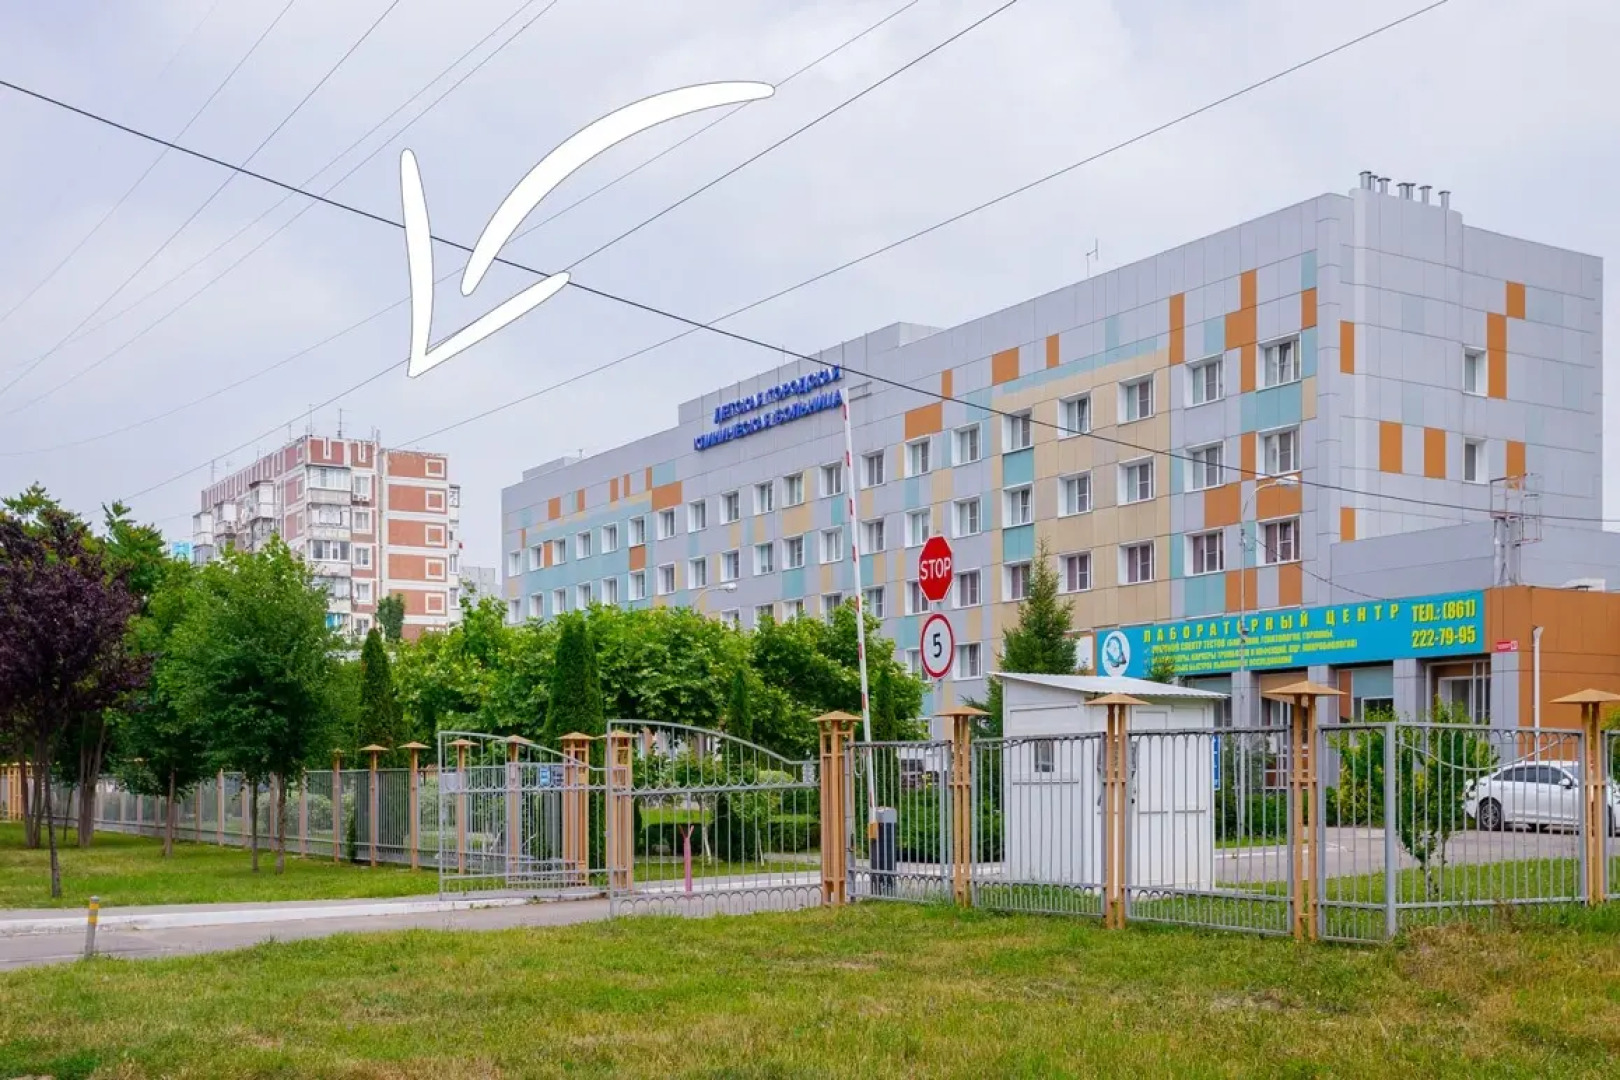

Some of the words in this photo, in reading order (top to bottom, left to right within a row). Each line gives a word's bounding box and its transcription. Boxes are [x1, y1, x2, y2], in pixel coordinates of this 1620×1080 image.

[714, 391, 763, 424] ДЕТСКАЯ
[765, 364, 840, 404] ГОРОДСКАЯ
[693, 415, 771, 451] КЛИНИЧЕСКАЯ
[772, 388, 843, 425] БОЛЬНИЦА
[920, 557, 951, 580] STOP
[1143, 610, 1308, 643] ЛАБОРАТОРНЫЙ
[1326, 603, 1399, 627] ЦЕНТР
[1412, 602, 1440, 622] ТЕЛ.:
[1443, 599, 1476, 619] (861)
[932, 632, 942, 658] 5
[1412, 625, 1476, 648] 222-79-95
